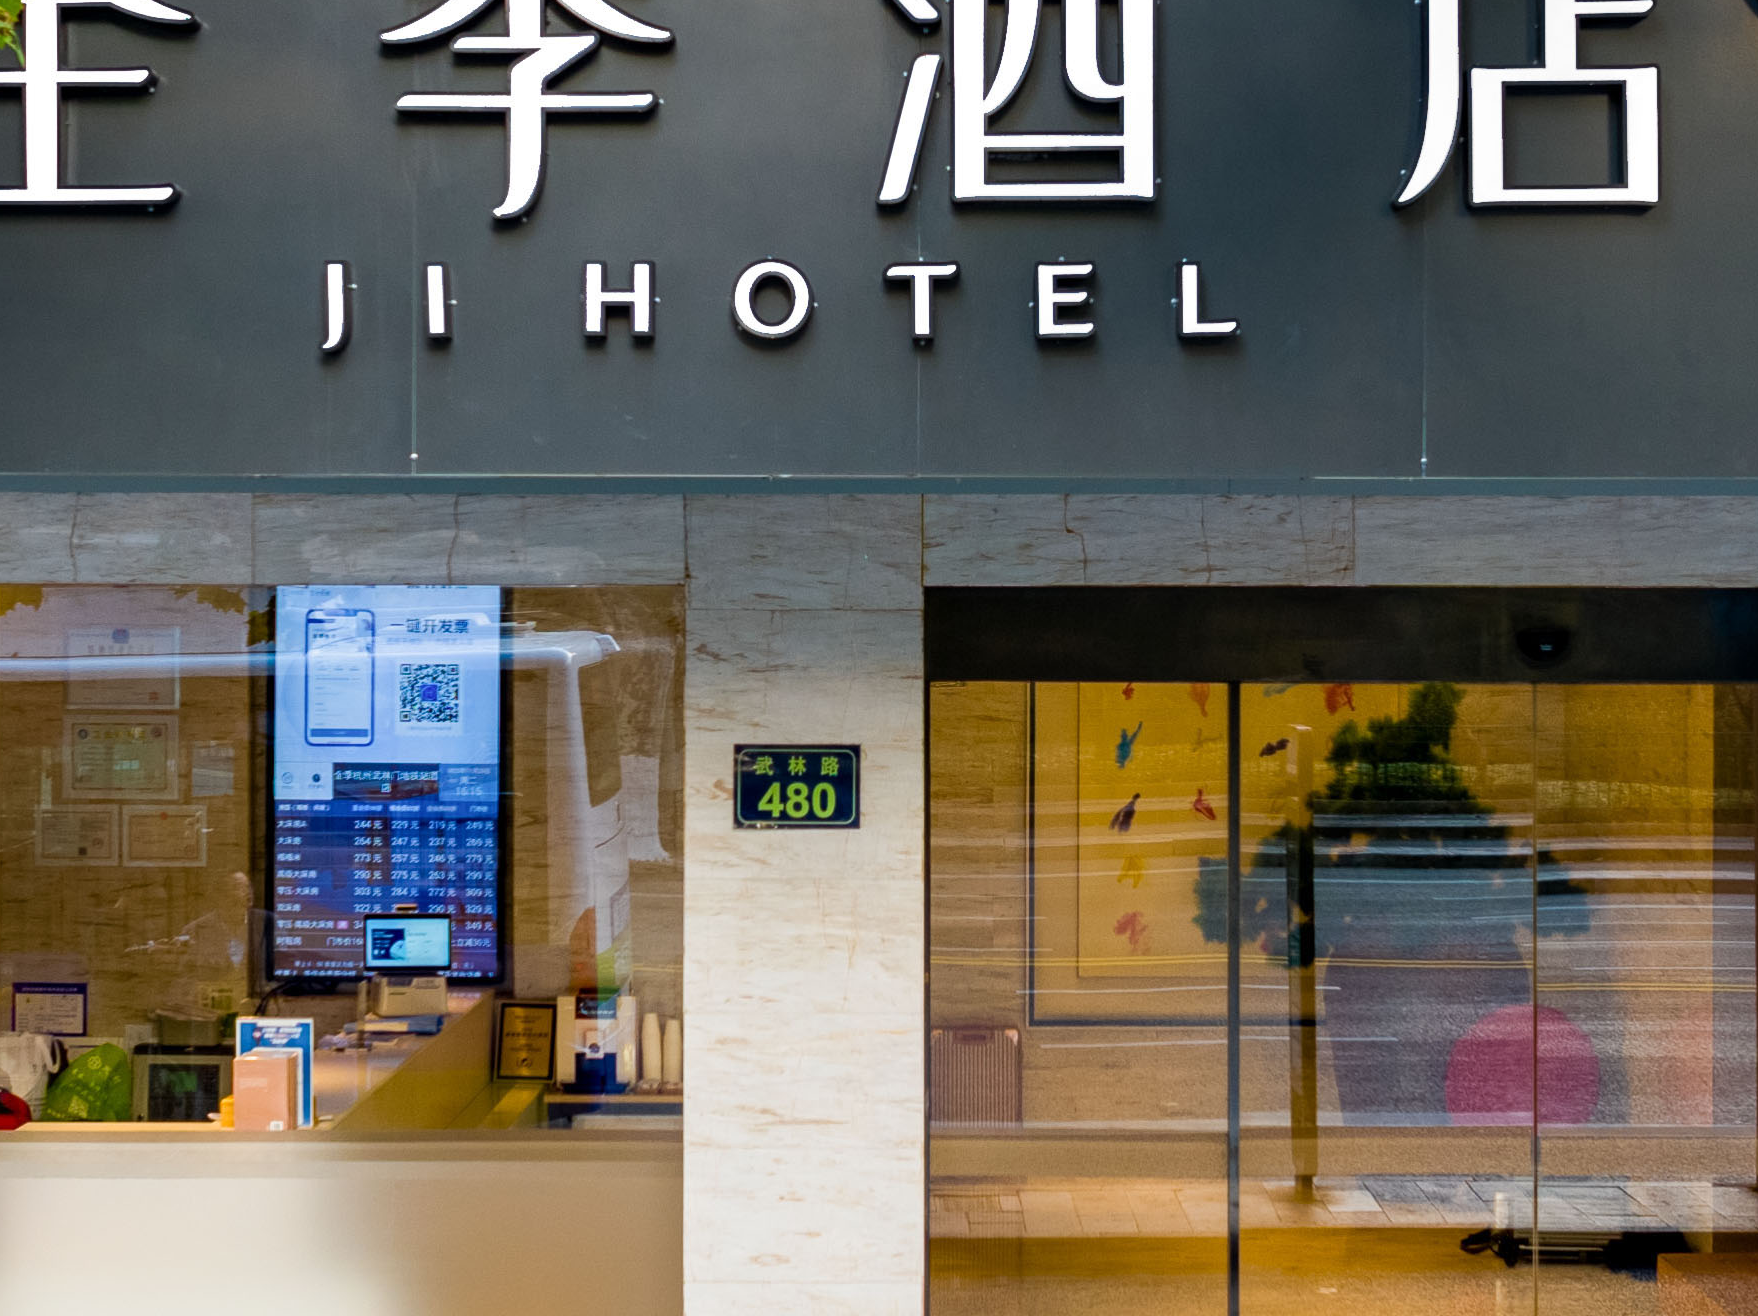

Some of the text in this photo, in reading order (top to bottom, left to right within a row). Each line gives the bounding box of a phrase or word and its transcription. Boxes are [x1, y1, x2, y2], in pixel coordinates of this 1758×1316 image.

[321, 258, 1239, 352] JI HOTEL
[755, 756, 840, 777] 武林路
[757, 782, 837, 819] 480
